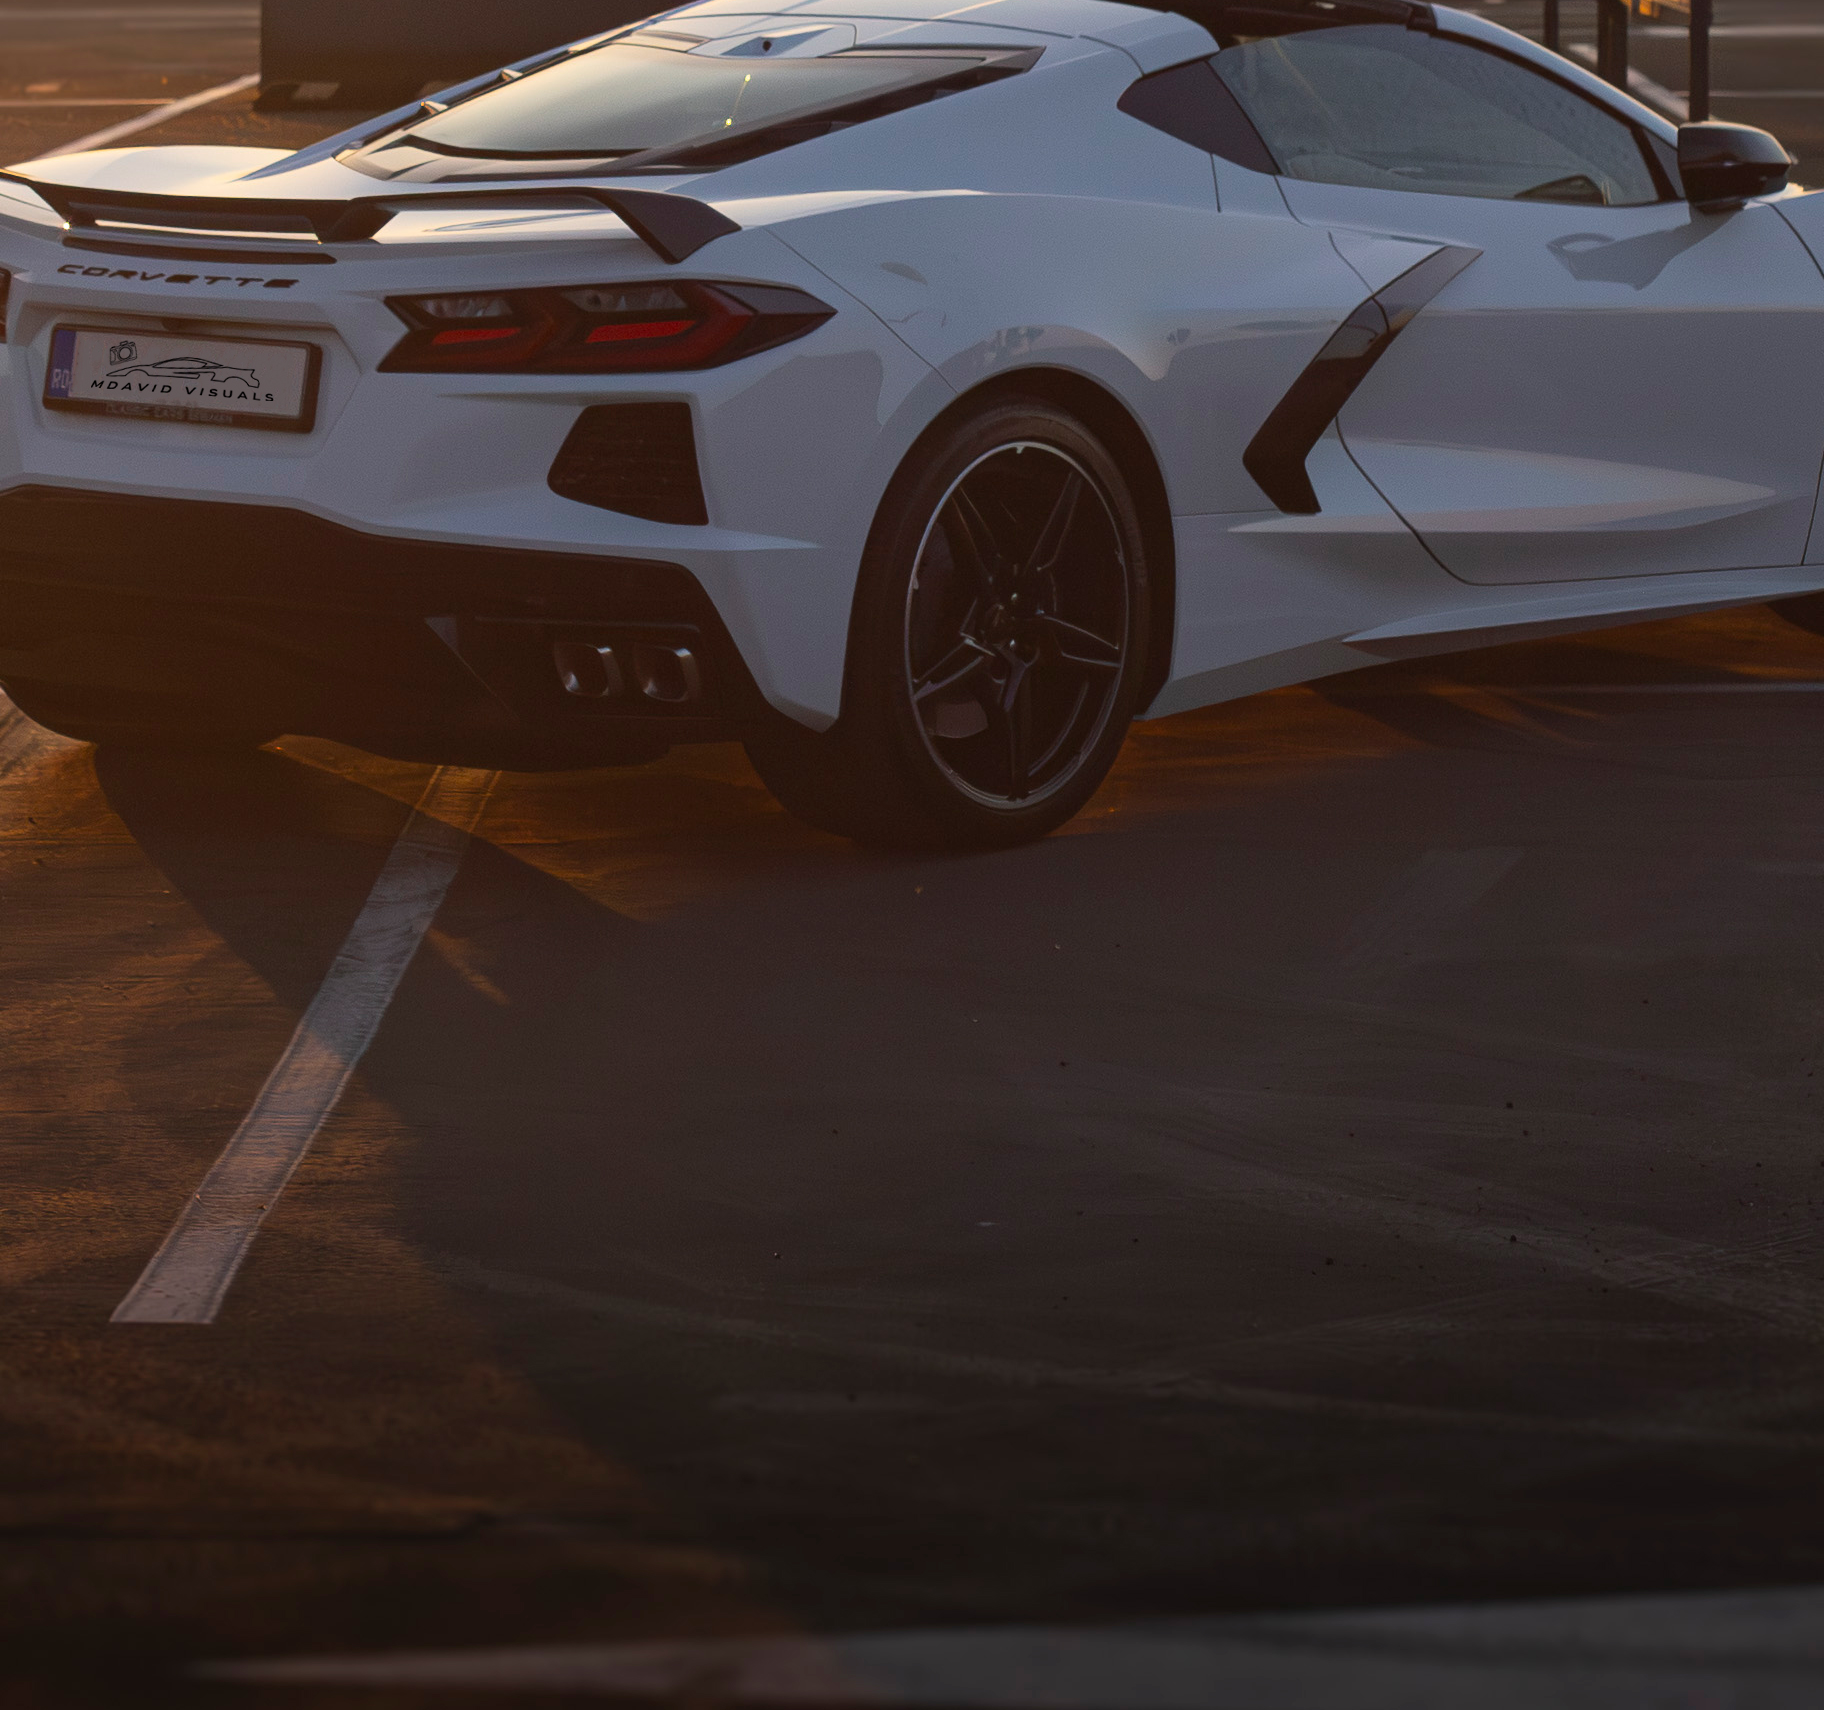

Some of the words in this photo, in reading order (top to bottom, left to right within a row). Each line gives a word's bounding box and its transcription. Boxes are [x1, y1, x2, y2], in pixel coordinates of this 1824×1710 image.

[57, 264, 300, 288] CORVETTE
[51, 368, 69, 389] RO
[90, 379, 173, 394] MDAVID
[185, 386, 275, 402] VISUALS
